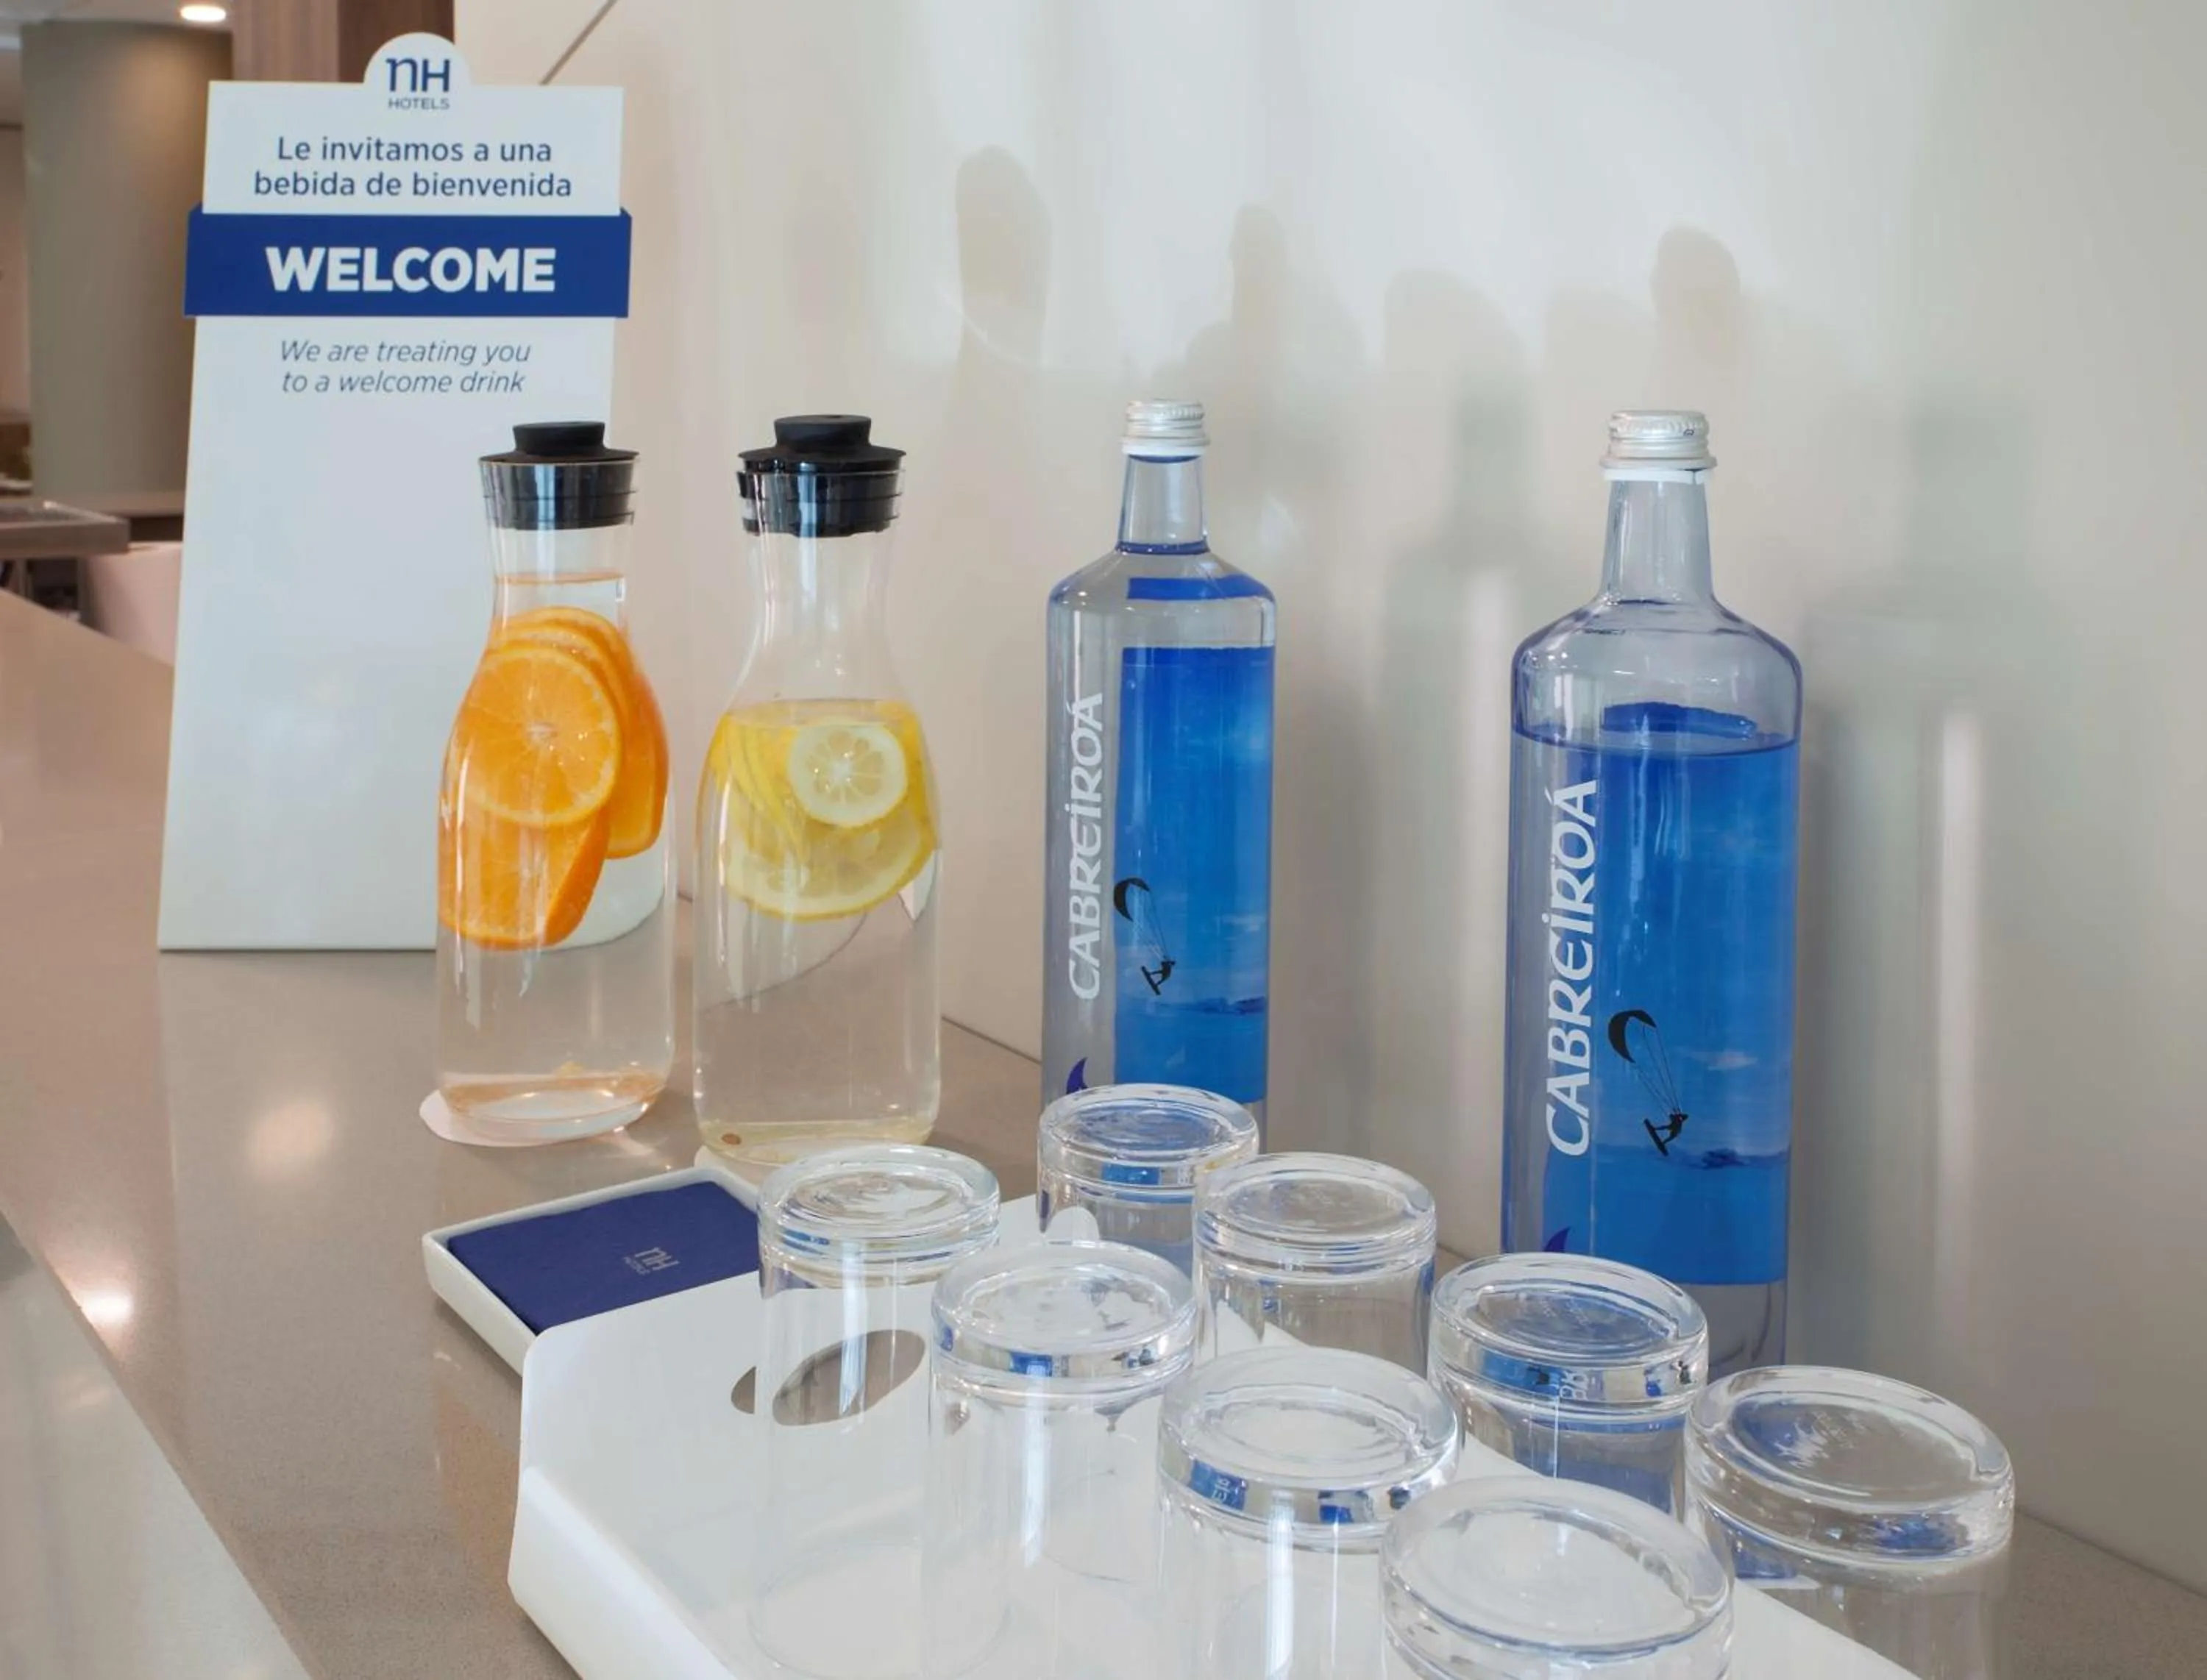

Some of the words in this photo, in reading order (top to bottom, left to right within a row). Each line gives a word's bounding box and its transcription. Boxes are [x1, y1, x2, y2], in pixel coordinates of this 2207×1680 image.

[388, 97, 450, 110] HOTELS
[278, 136, 311, 161] Le
[321, 136, 463, 162] invitamos
[473, 143, 489, 162] a
[500, 143, 552, 163] una
[254, 170, 355, 196] bebida
[366, 171, 402, 196] de
[413, 171, 572, 197] bienvenida
[266, 246, 556, 292] WELCOME
[281, 340, 321, 362] We
[327, 344, 369, 362] are
[377, 341, 477, 366] treating
[483, 345, 530, 366] you
[282, 371, 308, 393] to
[314, 375, 330, 393] a
[339, 370, 452, 393] welcome
[460, 371, 525, 393] drink
